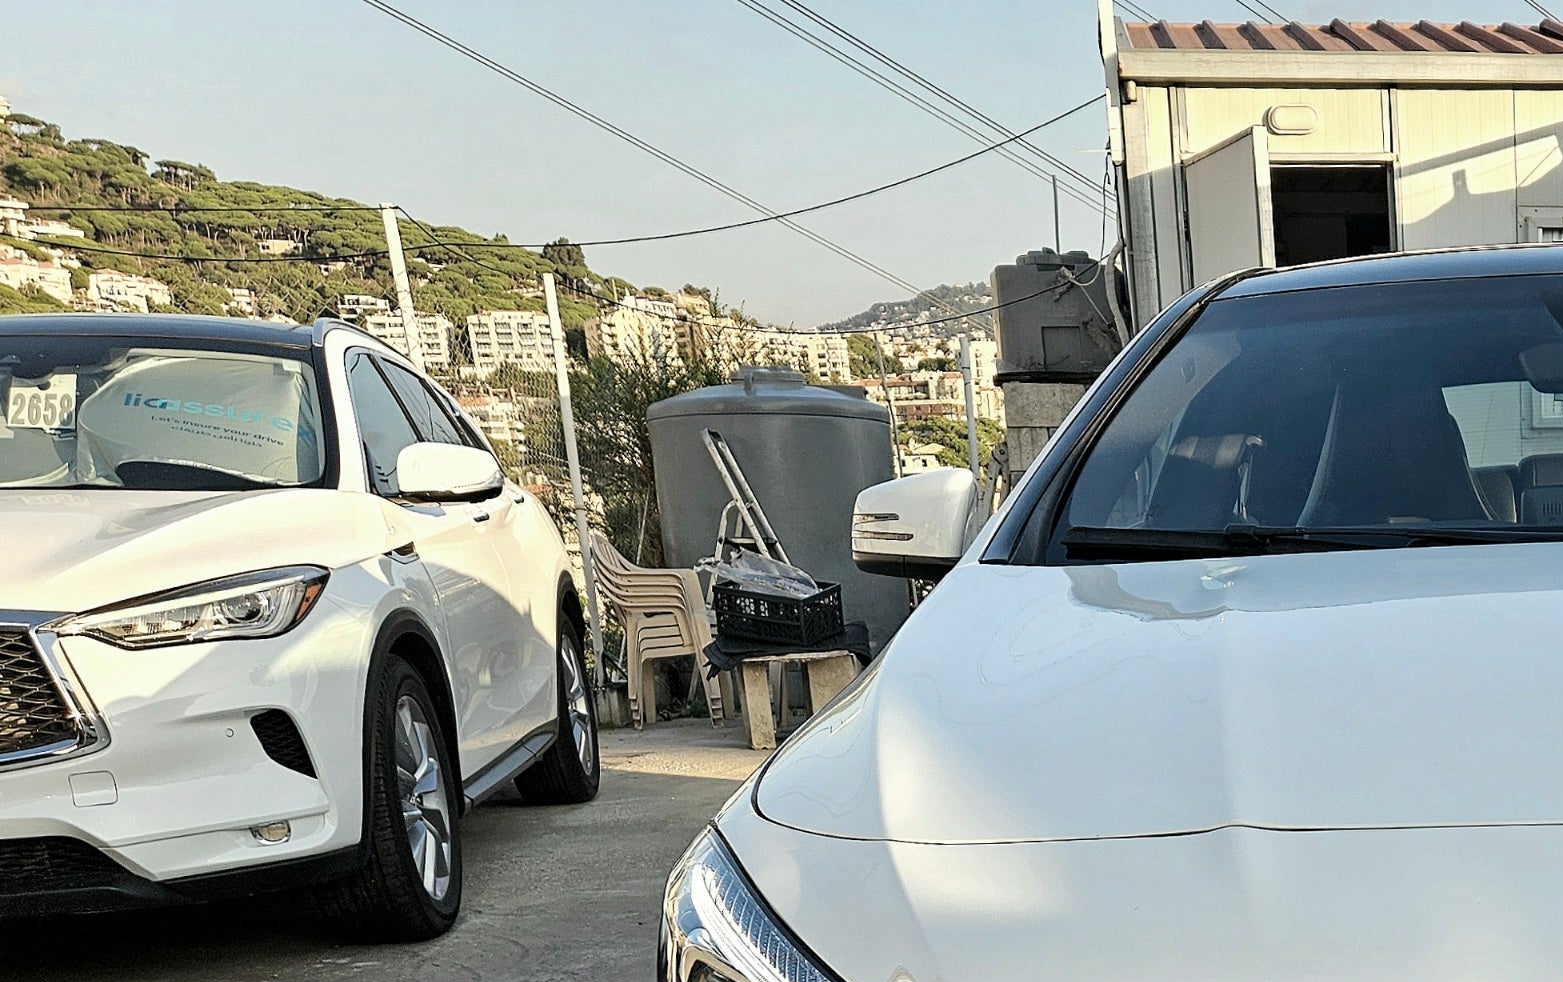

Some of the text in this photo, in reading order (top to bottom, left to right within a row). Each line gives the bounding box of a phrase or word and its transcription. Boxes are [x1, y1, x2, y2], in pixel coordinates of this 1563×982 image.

[11, 393, 73, 427] 2658
[223, 427, 252, 437] your
[253, 433, 284, 446] drive
